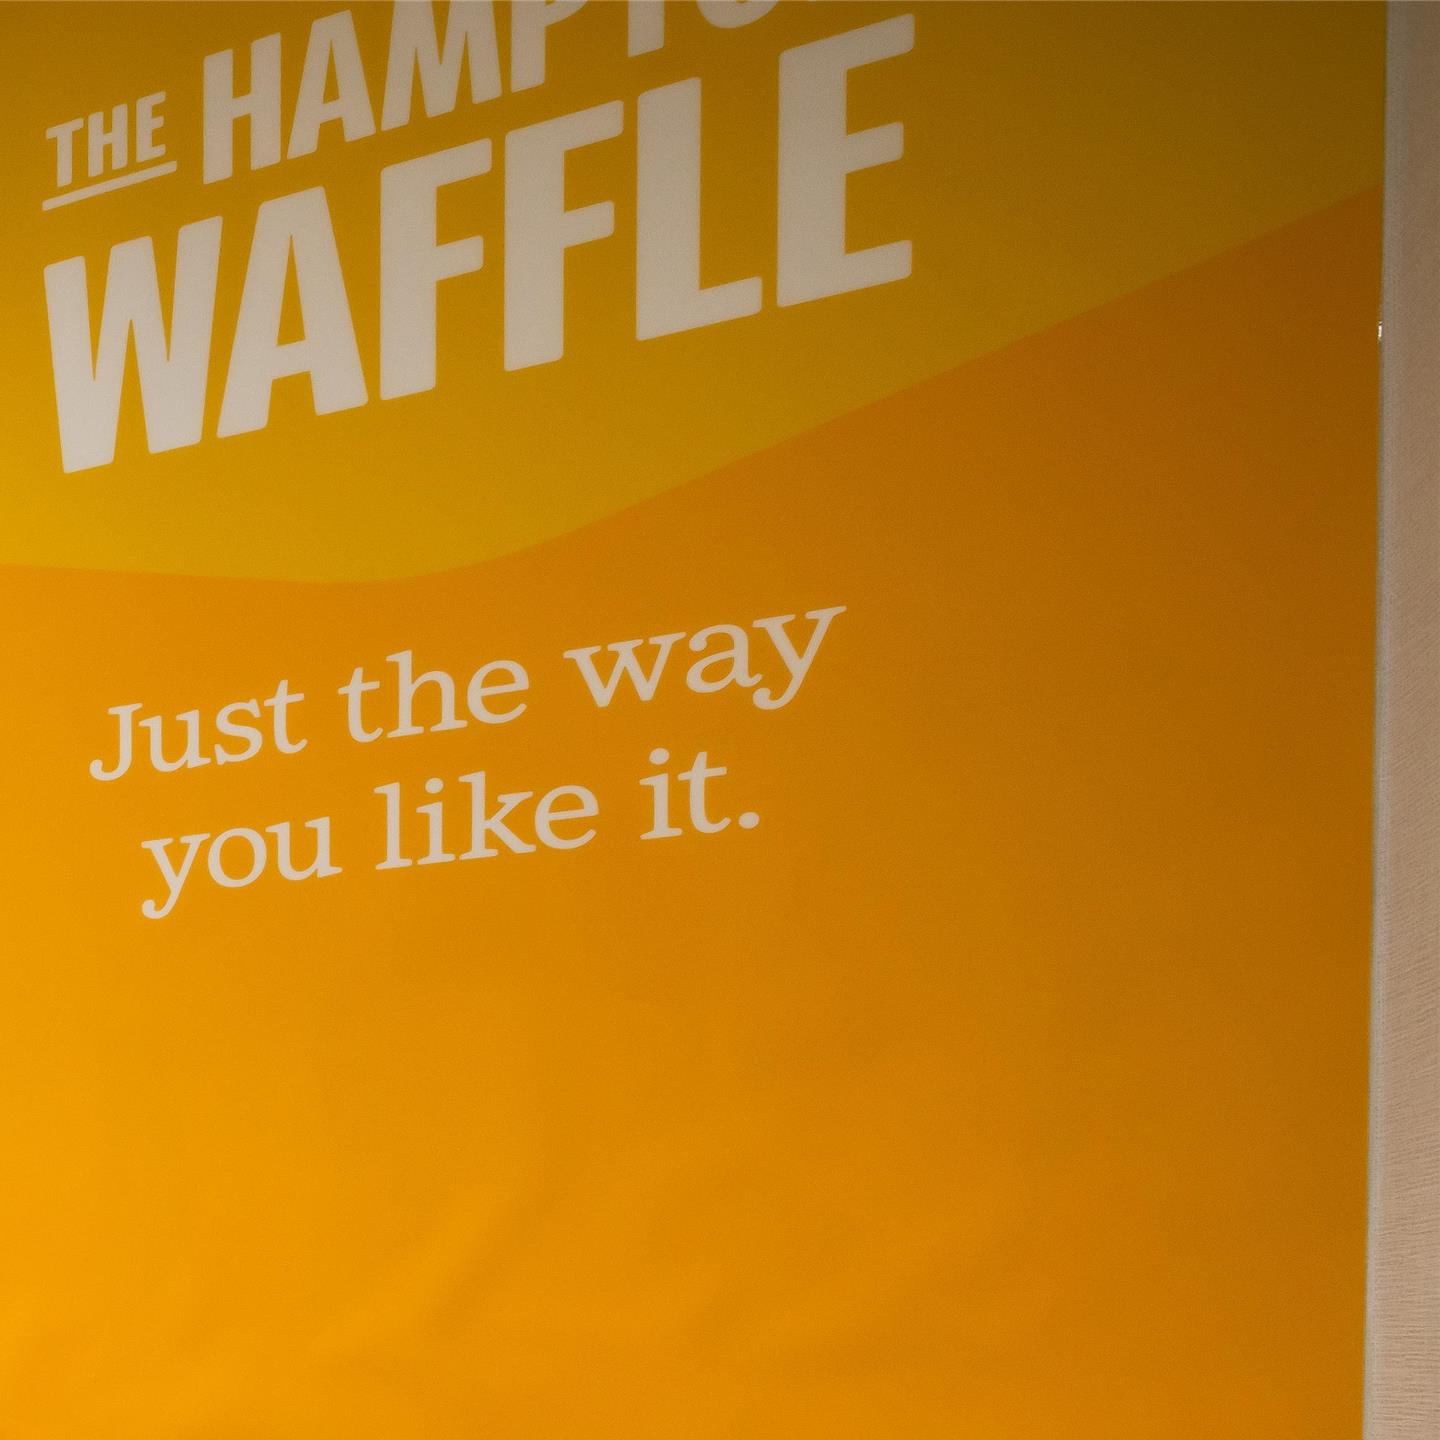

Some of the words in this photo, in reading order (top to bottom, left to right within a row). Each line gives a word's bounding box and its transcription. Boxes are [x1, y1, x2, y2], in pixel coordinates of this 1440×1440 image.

[45, 90, 166, 187] THE
[203, 0, 780, 184] HAMP
[43, 12, 915, 474] WAFFLE
[89, 678, 309, 782] Just
[337, 648, 529, 742] the
[563, 605, 847, 711] way
[141, 815, 342, 919] you
[373, 770, 600, 871] like
[638, 746, 761, 841] it.
